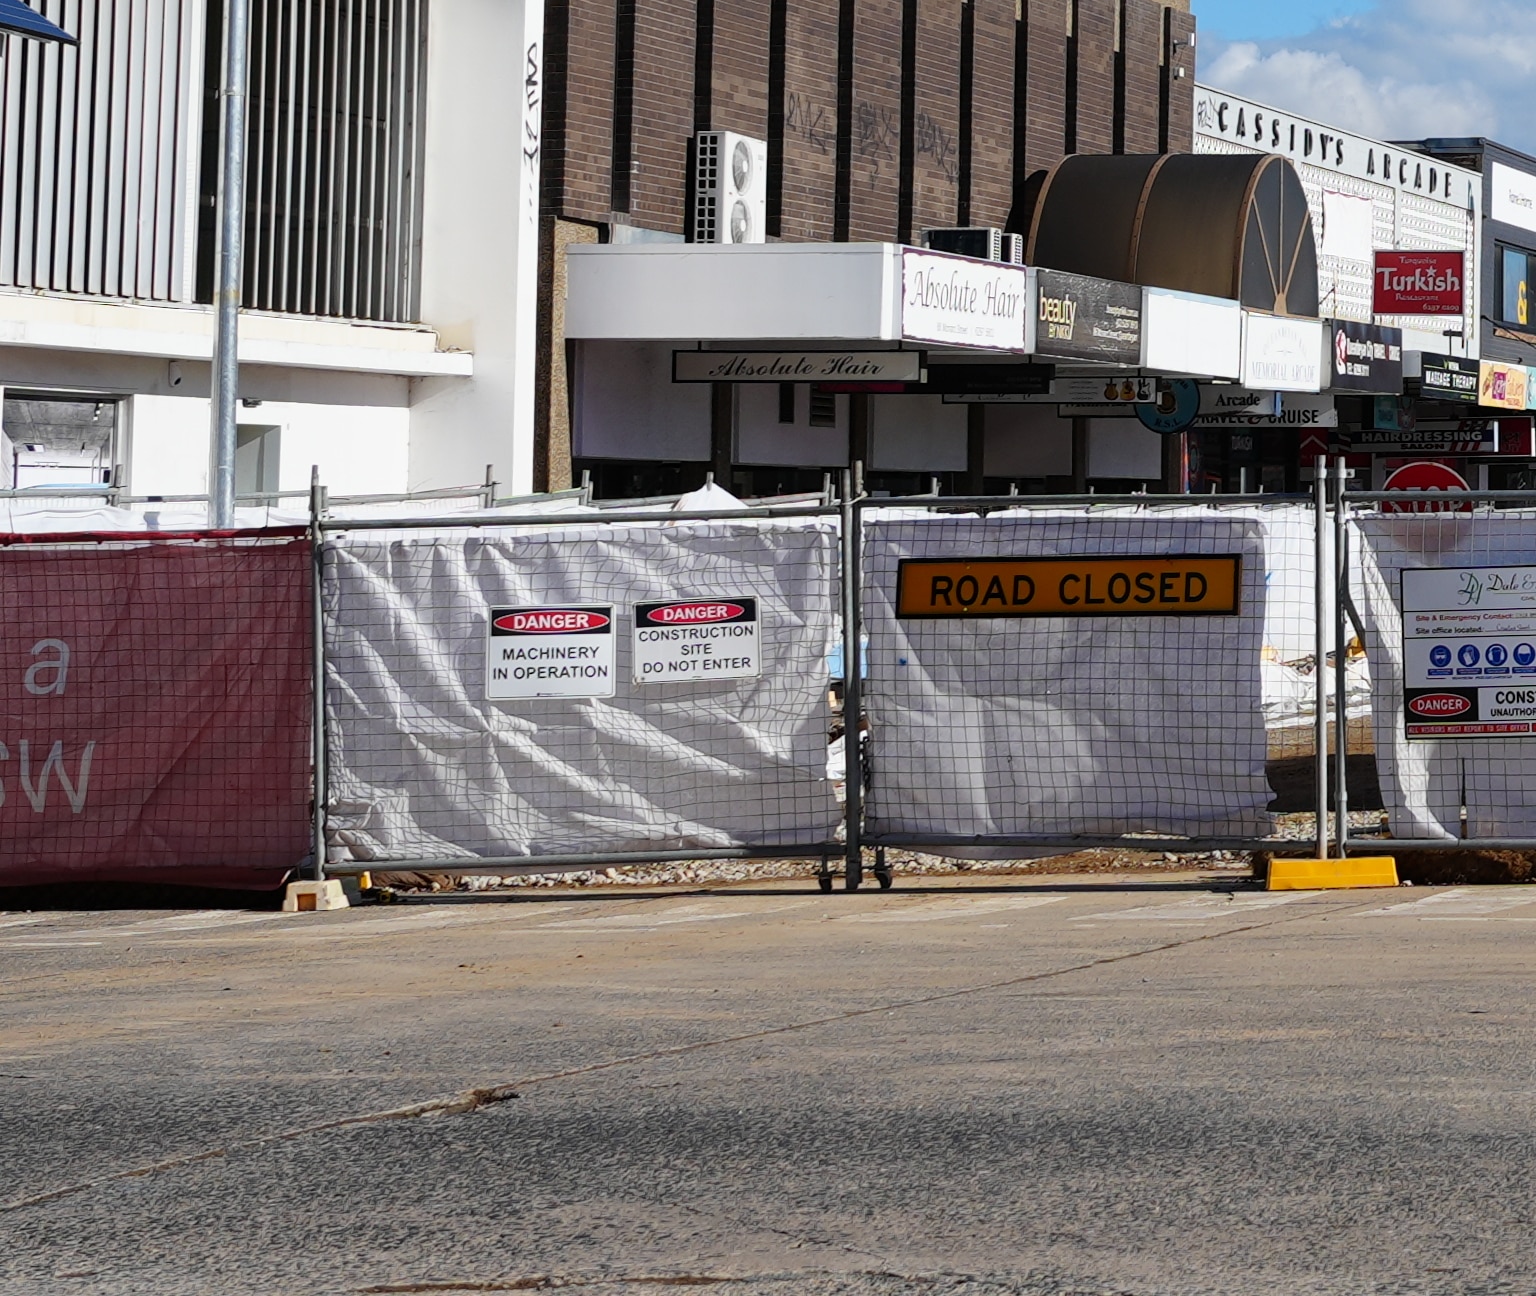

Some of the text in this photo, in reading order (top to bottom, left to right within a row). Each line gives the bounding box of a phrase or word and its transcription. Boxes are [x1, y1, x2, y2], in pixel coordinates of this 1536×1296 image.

[1218, 101, 1453, 199] CASSIDY'S ARCADE
[1375, 265, 1461, 292] Turkish
[909, 266, 1020, 320] Absolute Hair
[1040, 286, 1077, 340] beauty
[709, 355, 885, 378] Absolute Hair
[1216, 393, 1261, 407] Arcade
[1361, 430, 1483, 443] HAIRDRESSING
[1400, 442, 1445, 450] SALON
[930, 572, 1208, 607] ROAD CLOSED
[1487, 573, 1519, 591] Dale
[513, 612, 590, 631] DANGER
[663, 606, 728, 622] DANGER
[1439, 614, 1481, 622] Emergency
[638, 625, 754, 643] CONSTRUCTION
[1415, 627, 1430, 635] Site
[502, 647, 600, 662] MACHINERY
[681, 643, 713, 656] SITE
[493, 665, 609, 681] IN OPERATION
[642, 657, 751, 674] DO NOT ENTER
[1417, 699, 1463, 711] DANGER
